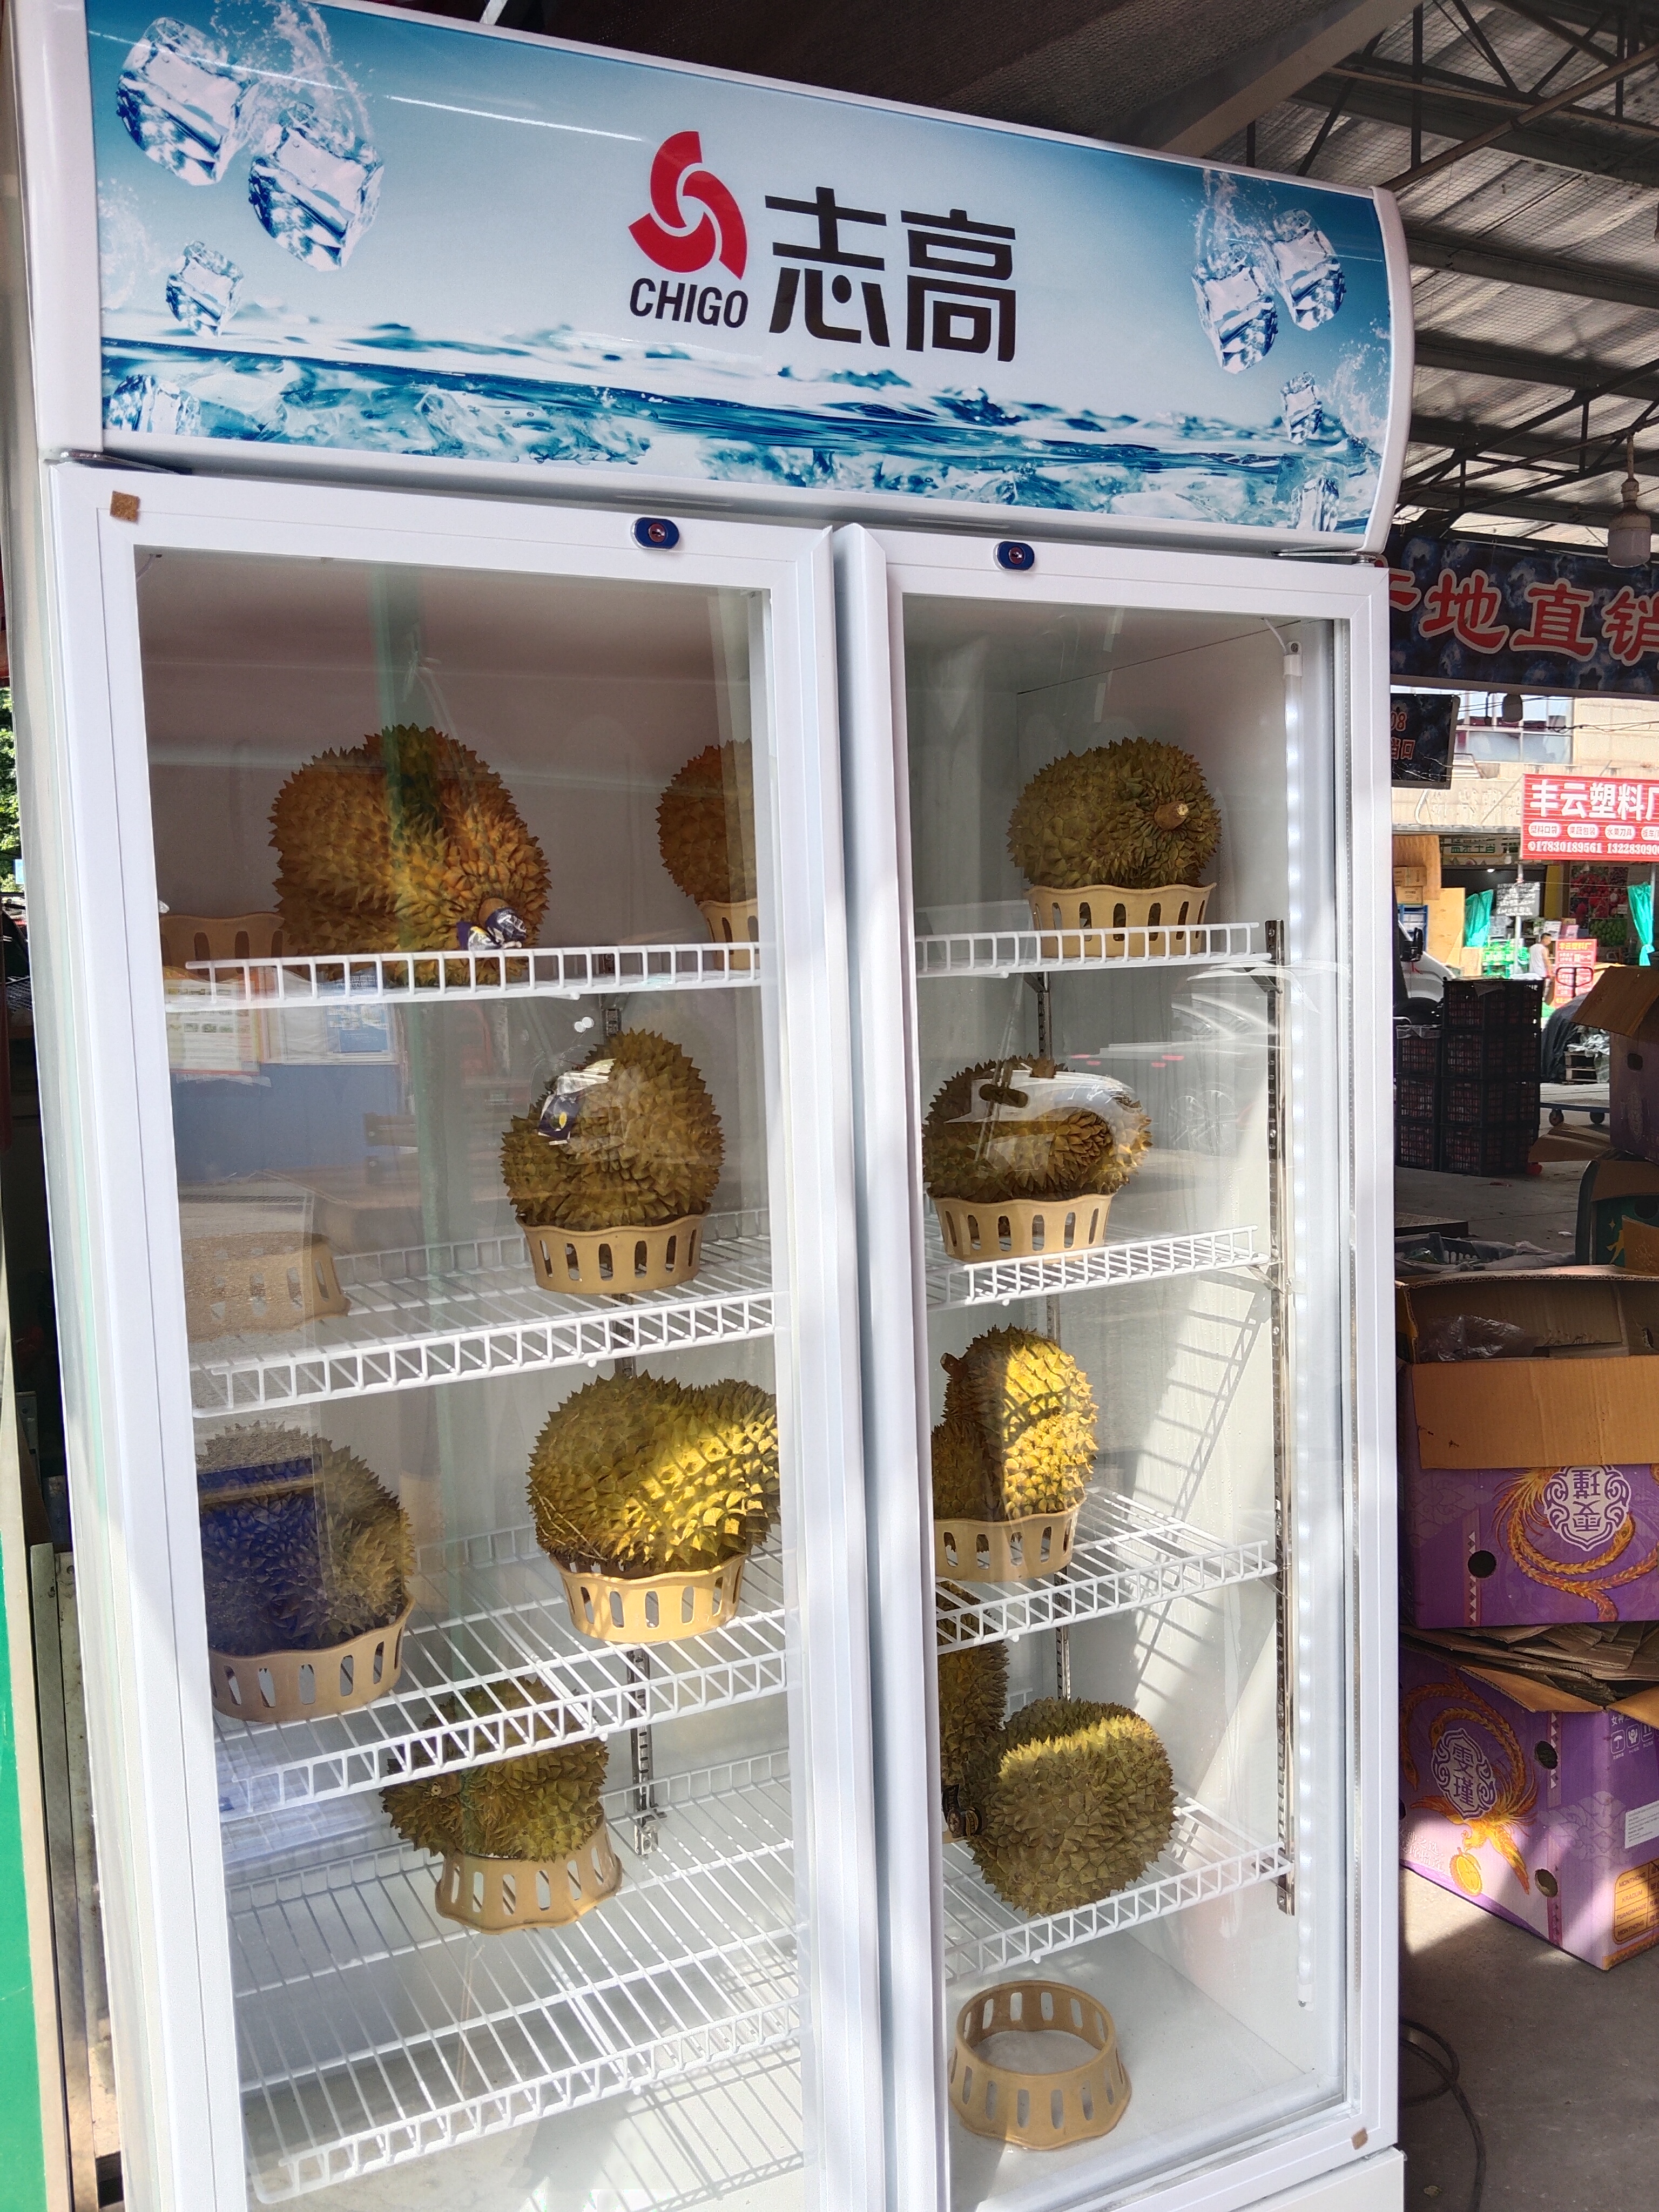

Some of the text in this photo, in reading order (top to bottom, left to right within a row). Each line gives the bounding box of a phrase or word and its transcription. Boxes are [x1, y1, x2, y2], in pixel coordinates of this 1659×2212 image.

[765, 186, 1016, 362] 志高
[630, 278, 748, 328] CHIGO
[1530, 825, 1557, 834] 塑料口袋
[1607, 843, 1659, 855] 132283090
